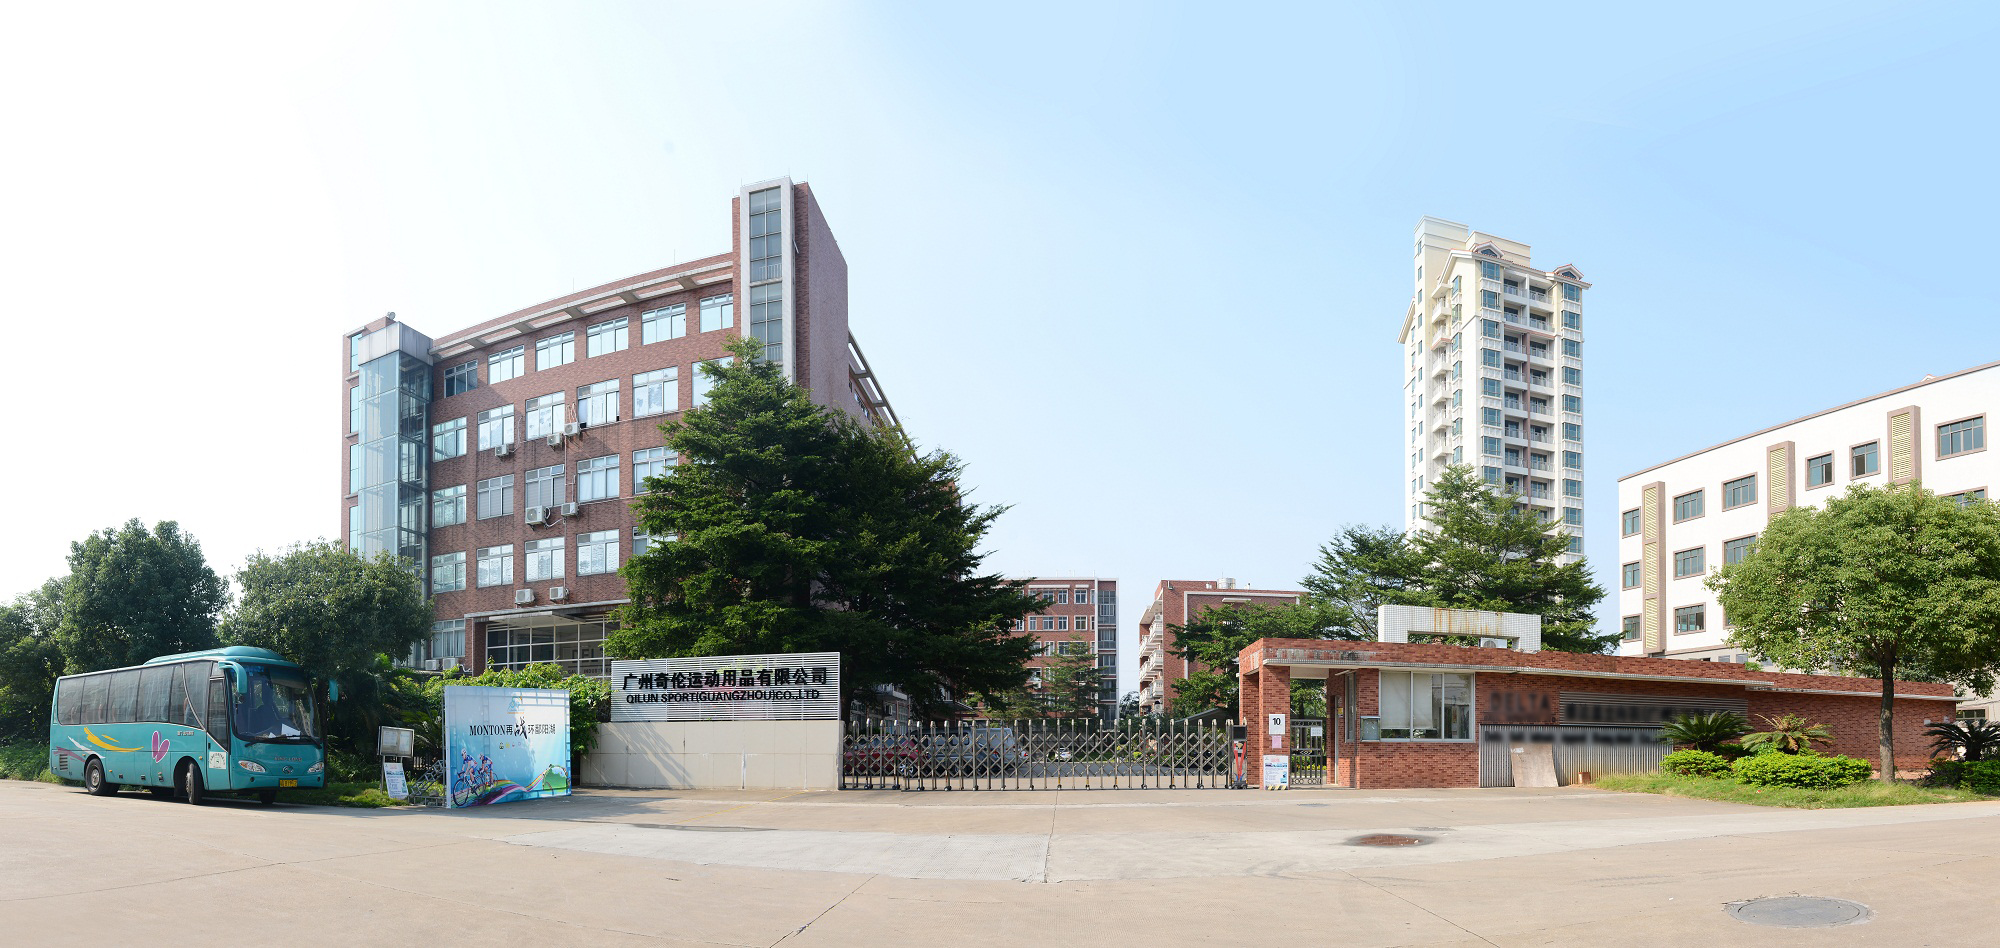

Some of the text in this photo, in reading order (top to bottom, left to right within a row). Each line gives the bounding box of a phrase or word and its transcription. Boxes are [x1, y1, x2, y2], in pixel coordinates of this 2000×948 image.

[622, 667, 827, 690] 广州奇伦运动用品有限公司
[626, 693, 658, 704] QILUN
[1272, 717, 1281, 725] 10
